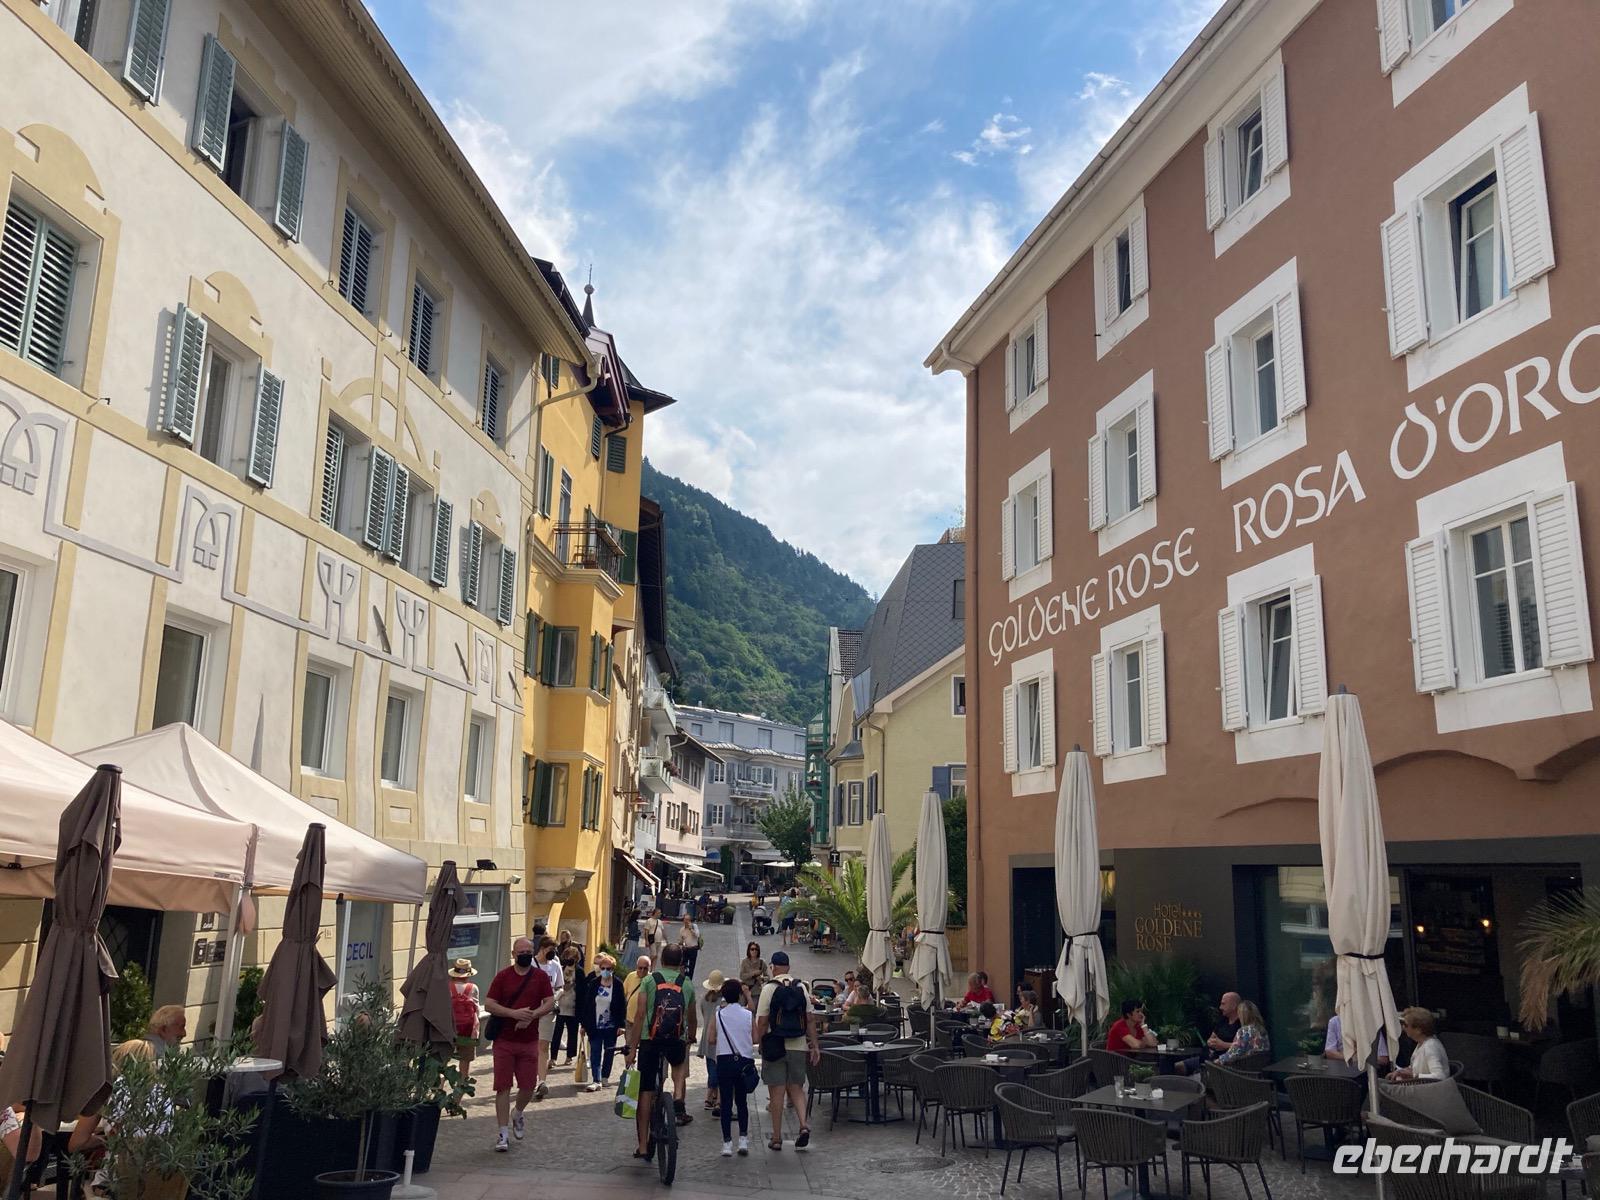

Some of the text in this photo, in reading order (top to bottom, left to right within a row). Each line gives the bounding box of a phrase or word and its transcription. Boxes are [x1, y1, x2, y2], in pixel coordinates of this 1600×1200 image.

[988, 577, 1101, 666] GOLDENE
[1107, 527, 1200, 611] ROSE
[1232, 449, 1367, 553] ROSA
[1153, 902, 1183, 918] Hotel
[1135, 916, 1203, 938] GOLDENE
[346, 942, 373, 961] CECIL
[1136, 933, 1172, 953] ROSE
